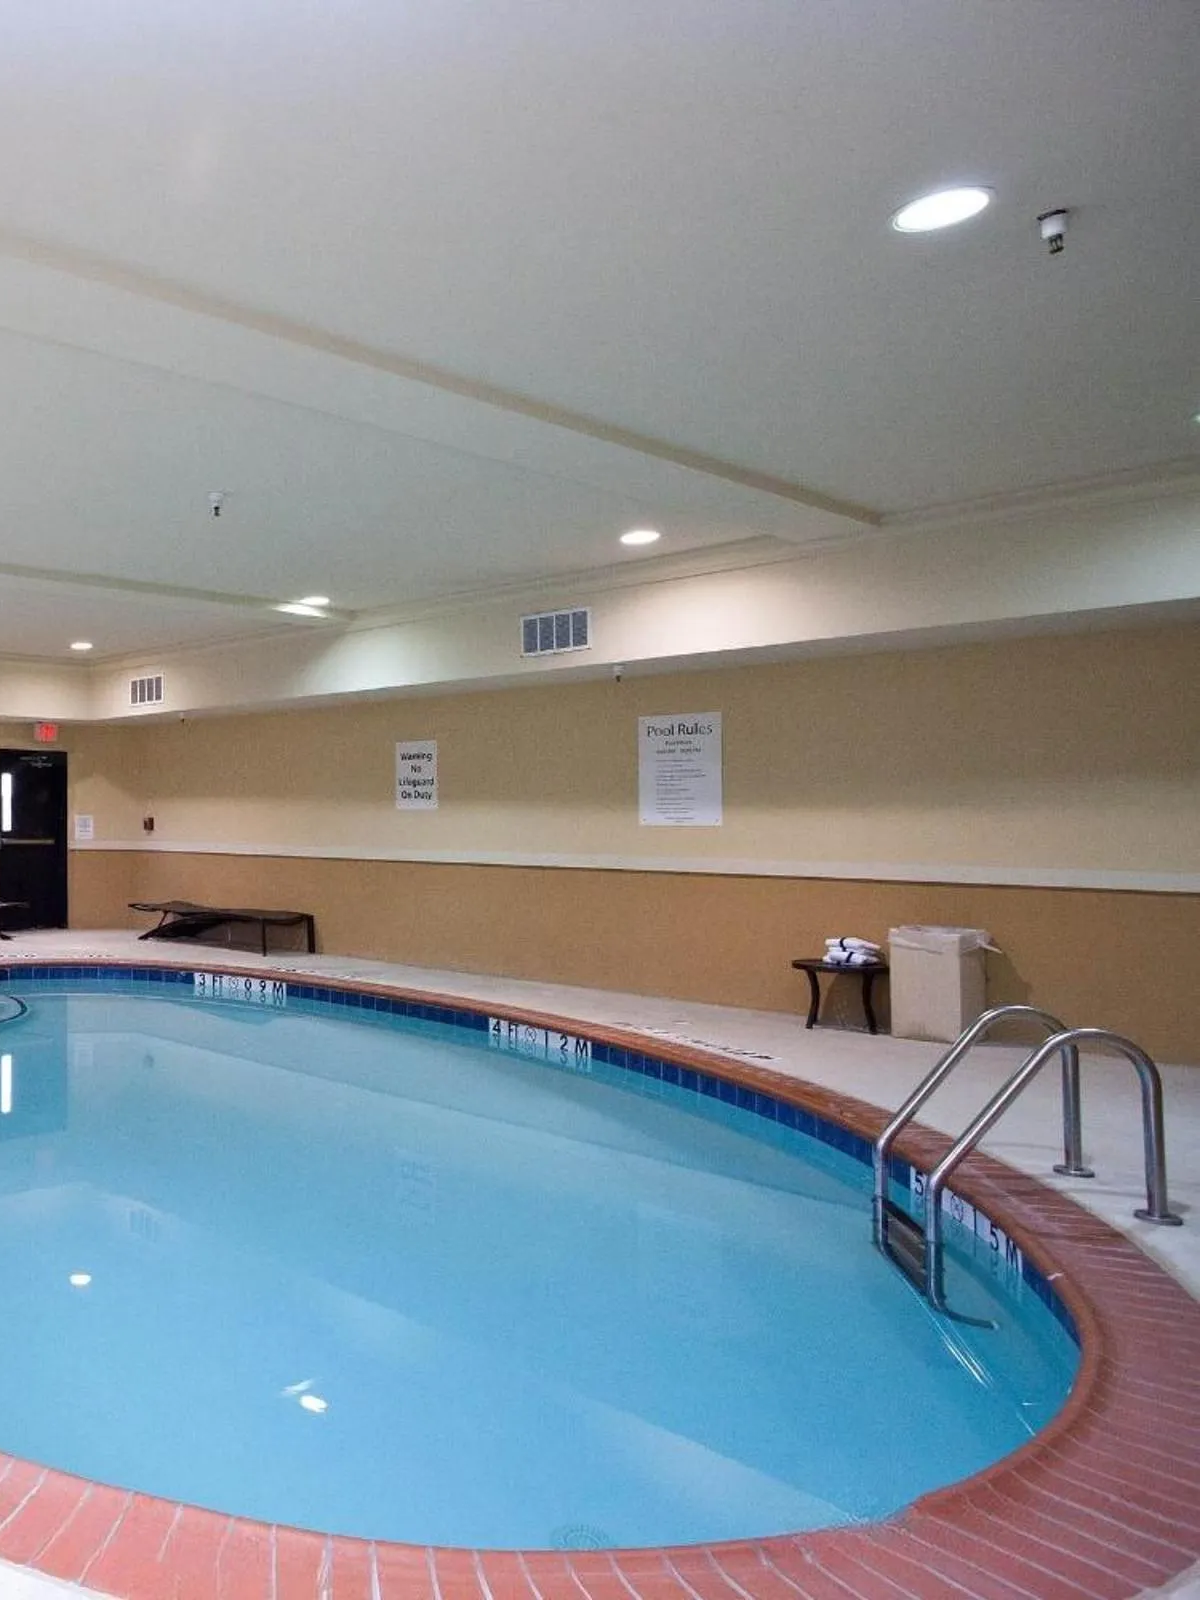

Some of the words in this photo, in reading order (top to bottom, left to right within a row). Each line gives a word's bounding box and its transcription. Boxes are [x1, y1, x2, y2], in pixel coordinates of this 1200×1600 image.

[647, 724, 675, 737] Pool
[678, 722, 713, 735] Rules
[410, 765, 421, 773] No
[414, 790, 432, 800] Duty
[560, 1032, 568, 1051] 2
[575, 1037, 588, 1057] M
[914, 1171, 923, 1195] 5
